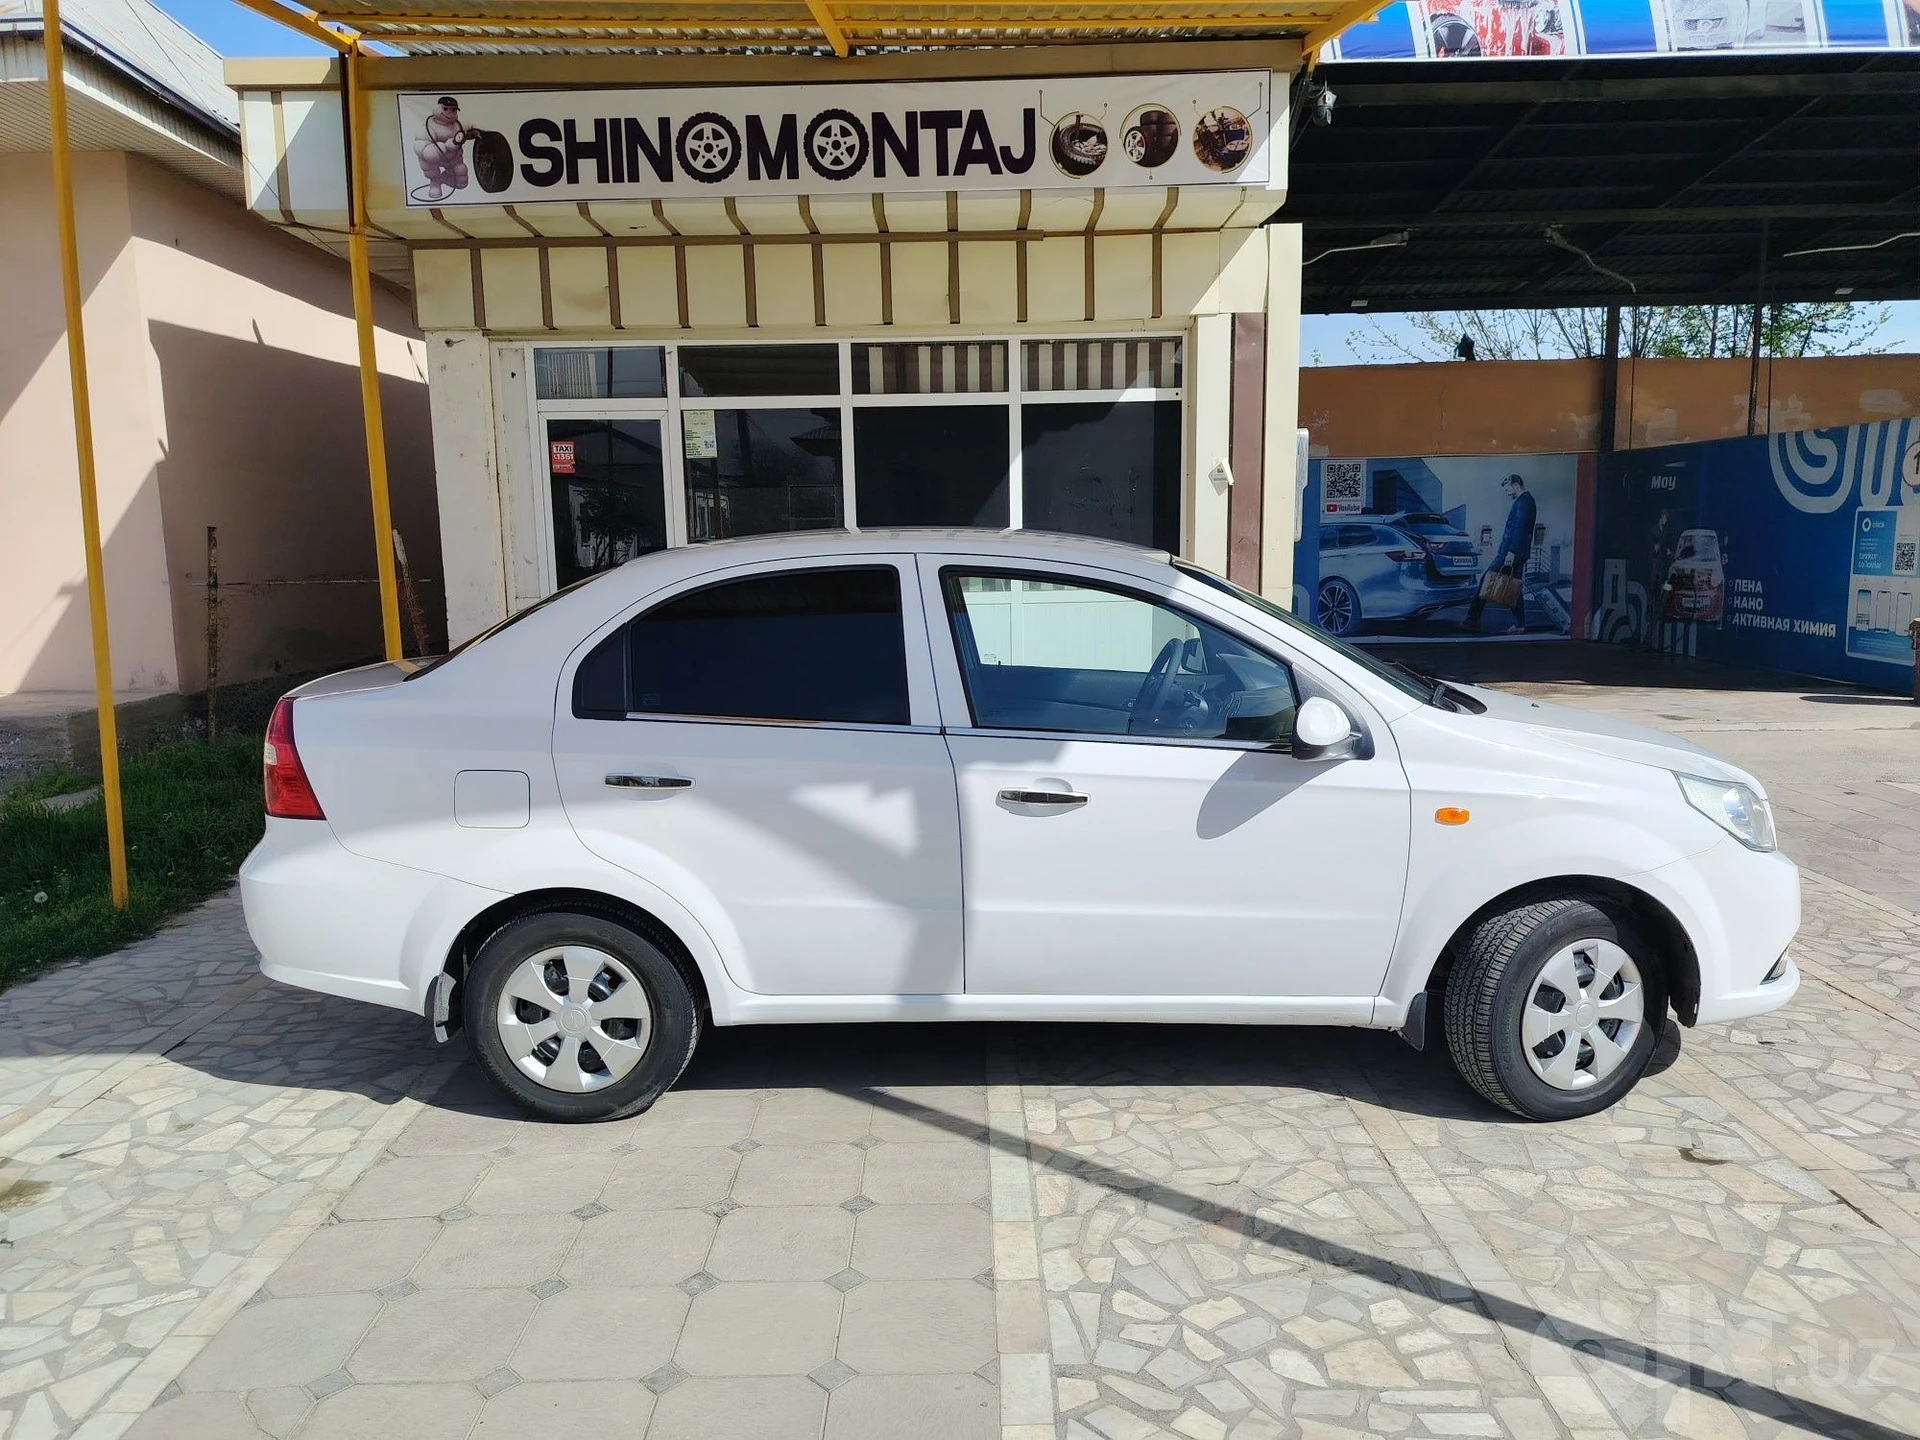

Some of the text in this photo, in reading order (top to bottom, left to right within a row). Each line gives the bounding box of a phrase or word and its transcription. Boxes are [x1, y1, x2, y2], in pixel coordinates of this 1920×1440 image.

[518, 108, 1036, 187] SHINOMONTAJ
[1735, 579, 1763, 594] ПЕНА
[1733, 596, 1764, 610] НАНО
[1732, 613, 1837, 638] АКТИВНАЯ ХИМИЯ
